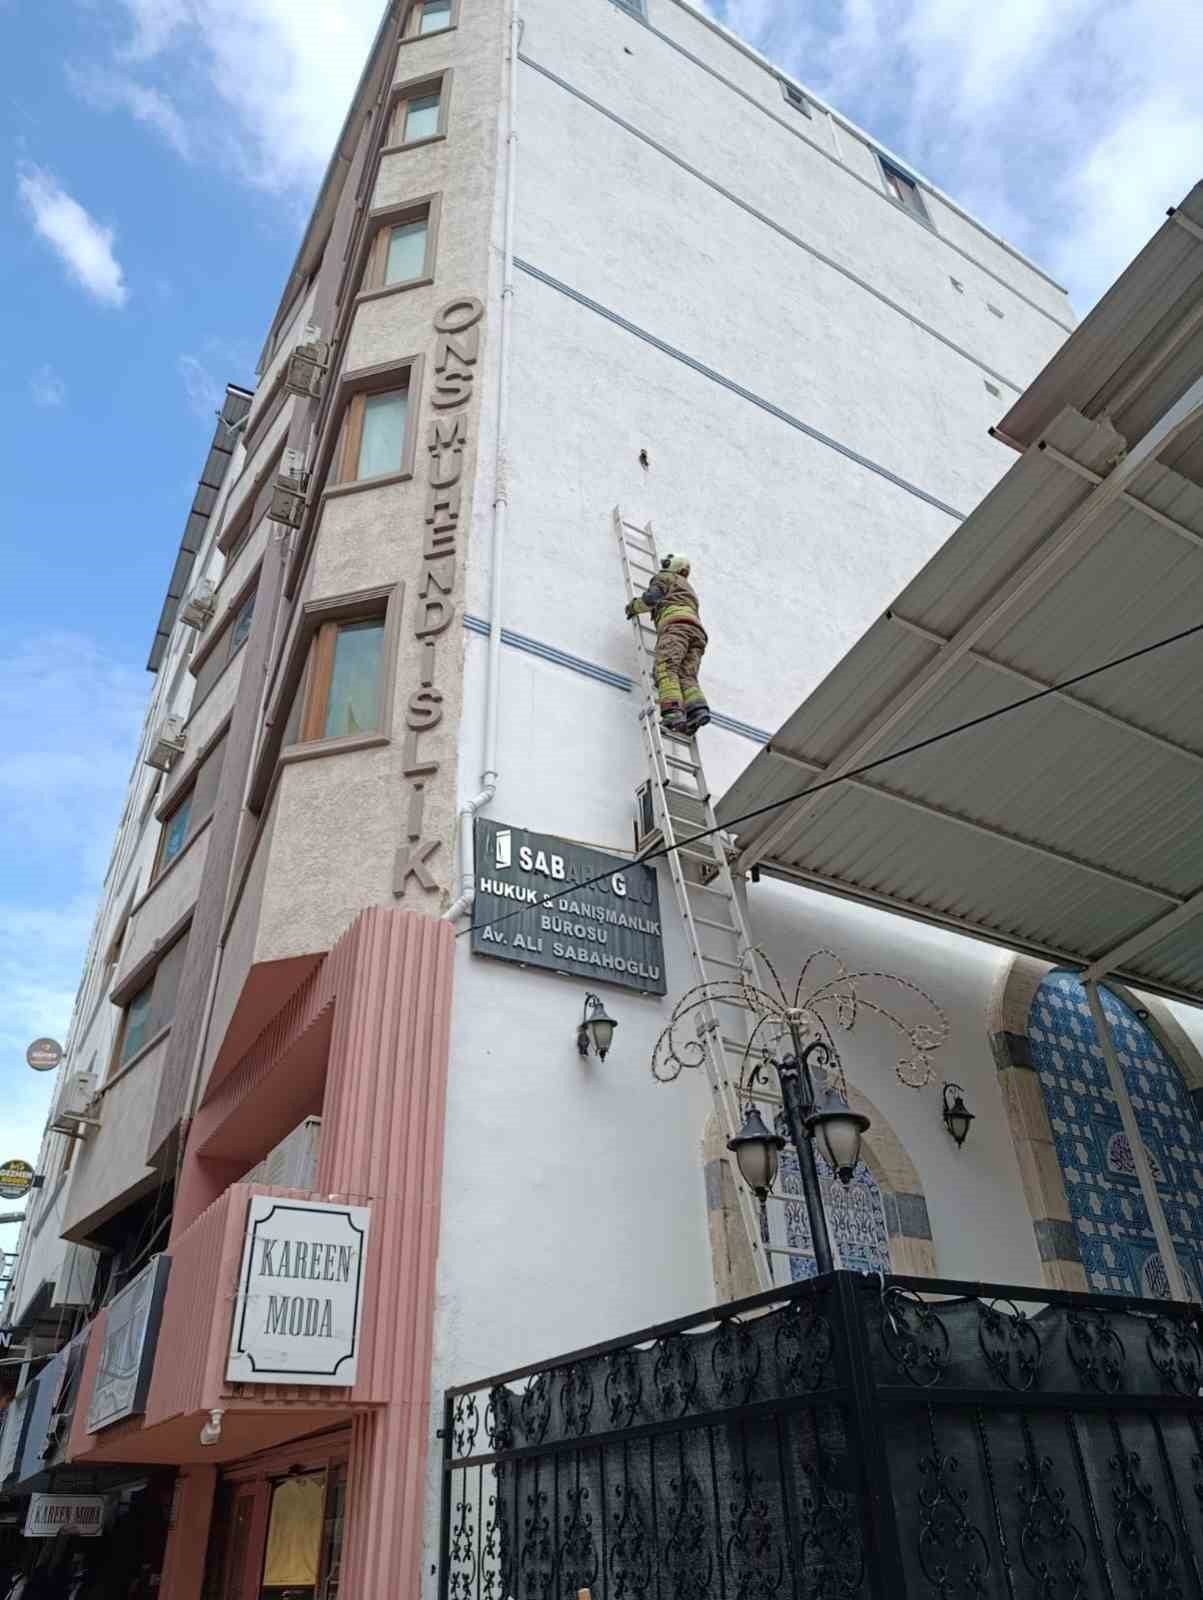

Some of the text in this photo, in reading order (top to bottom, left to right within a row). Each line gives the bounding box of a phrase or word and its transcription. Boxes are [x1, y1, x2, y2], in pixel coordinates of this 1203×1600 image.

[480, 877, 537, 904] HUKUK
[543, 894, 554, 909] &
[258, 1238, 353, 1283] KAREEN
[264, 1295, 334, 1338] MODA
